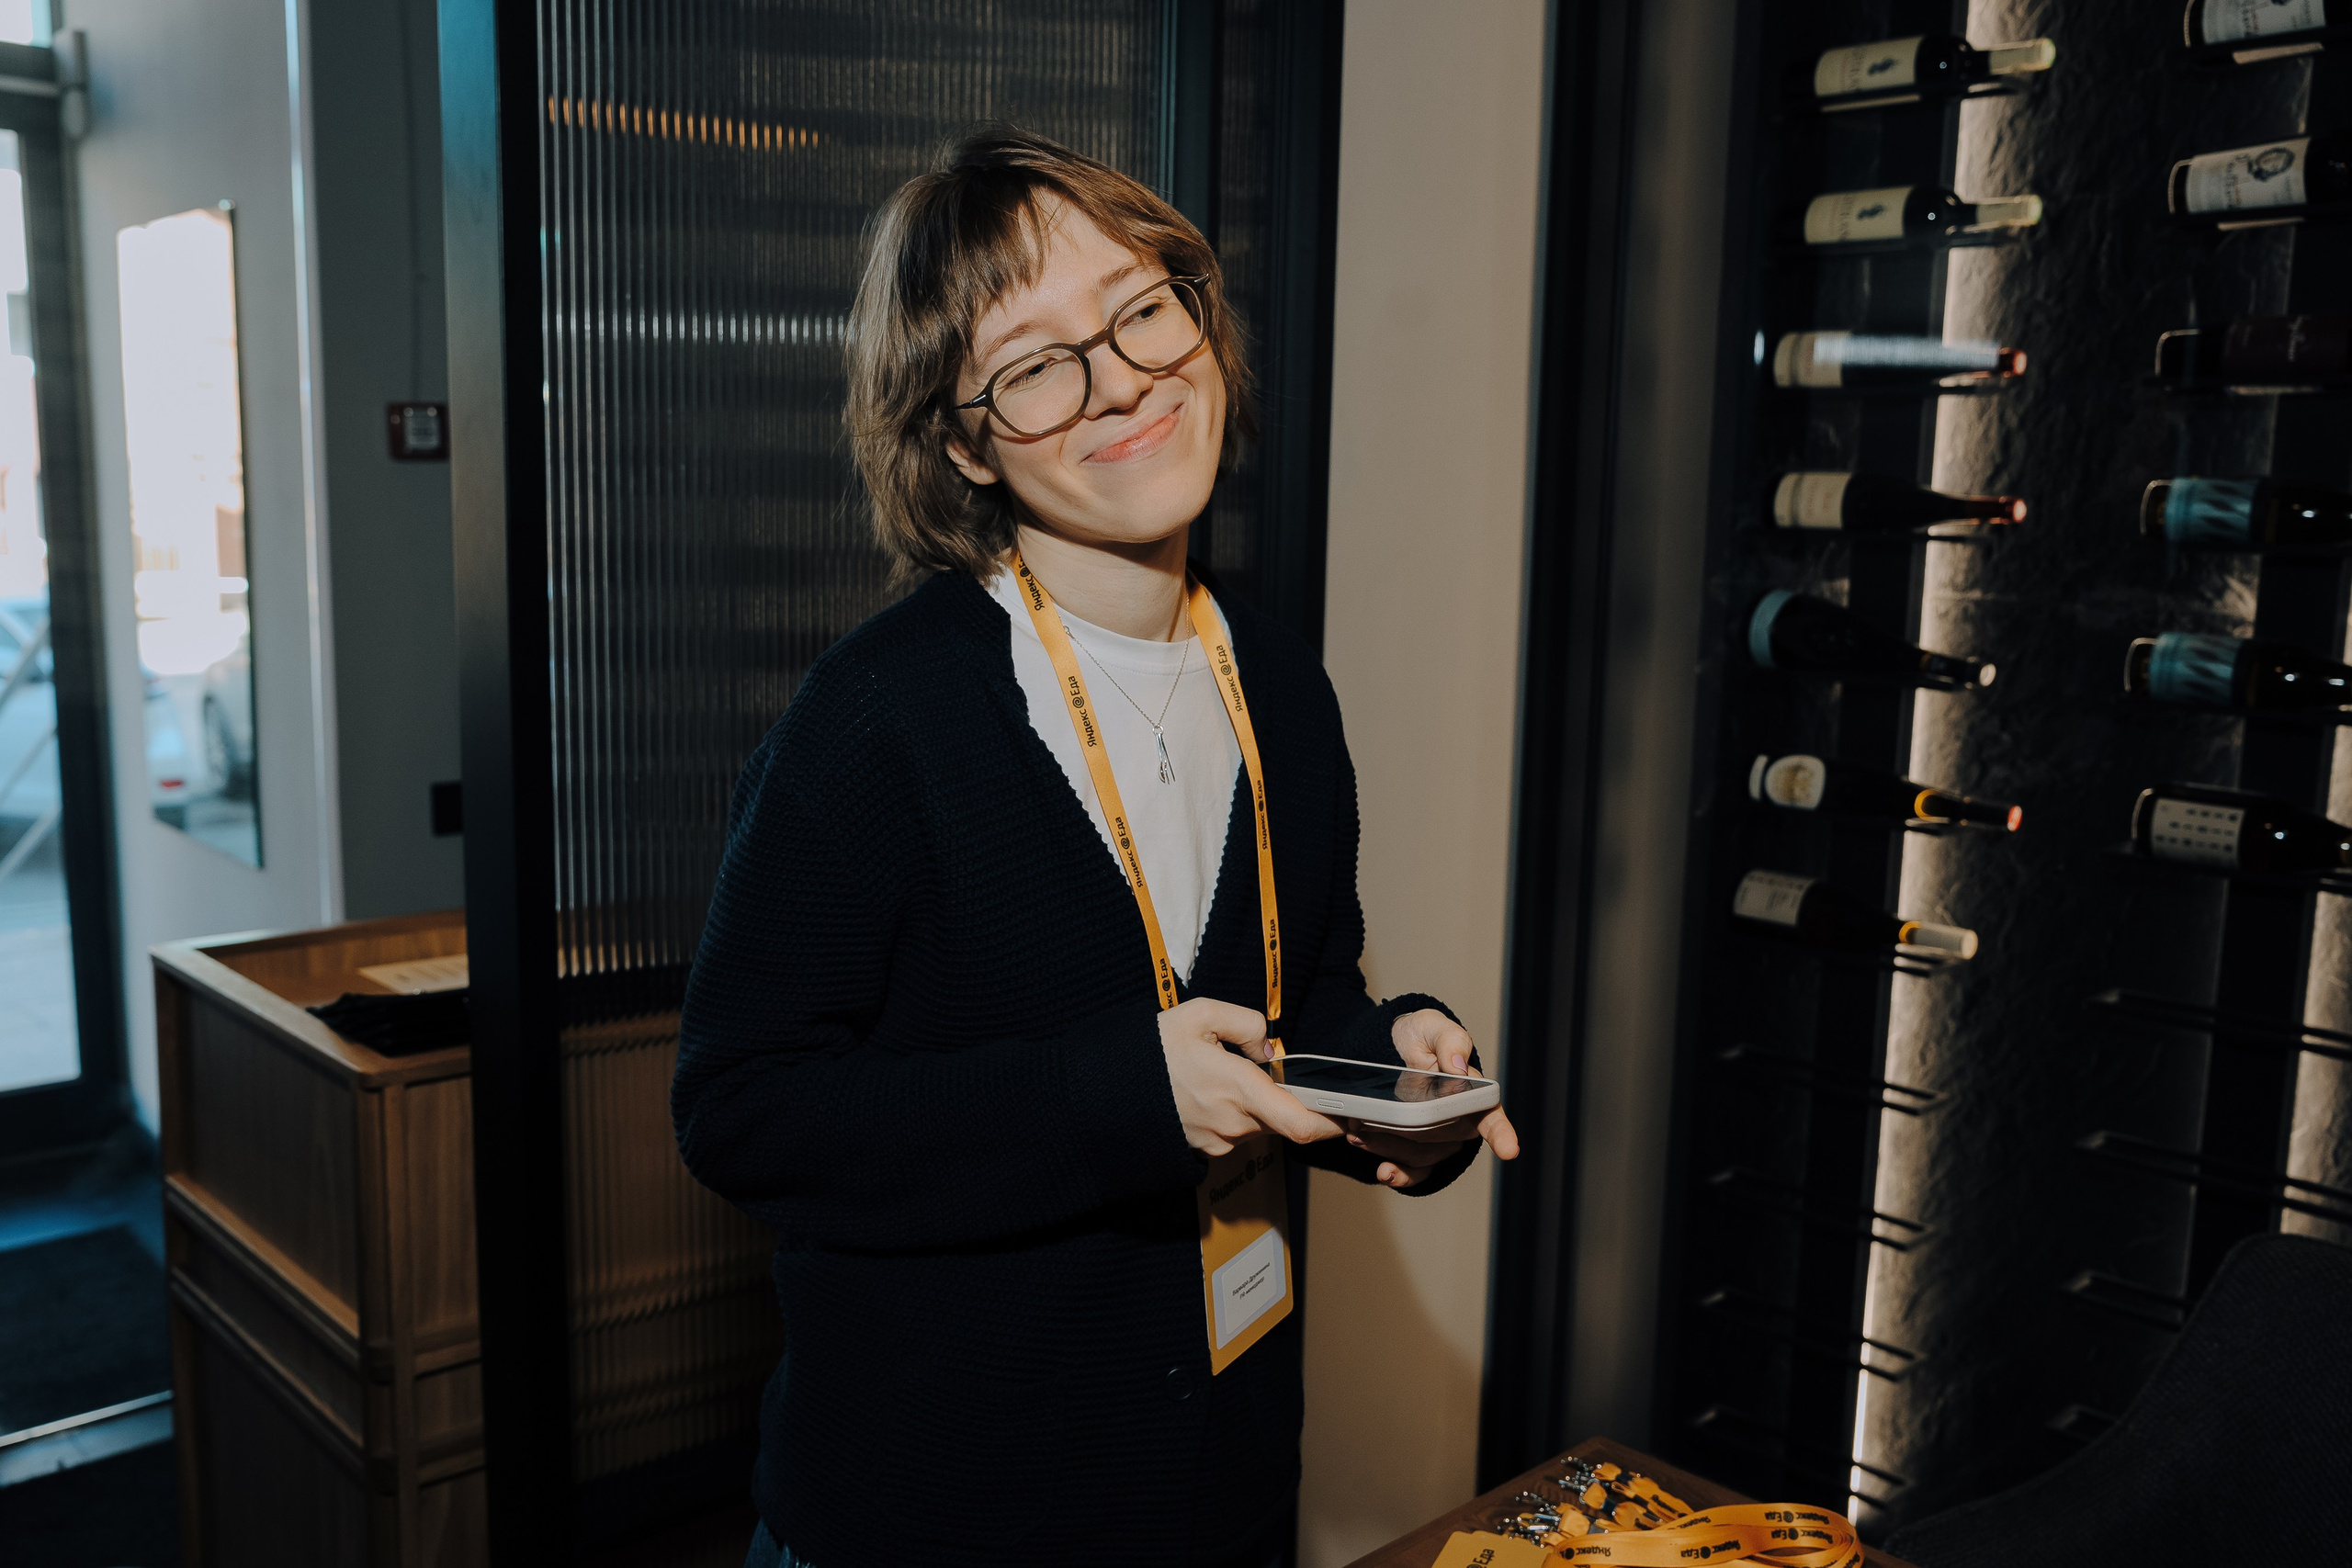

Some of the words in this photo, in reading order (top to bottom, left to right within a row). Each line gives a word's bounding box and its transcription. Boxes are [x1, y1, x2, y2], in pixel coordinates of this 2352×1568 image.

[1026, 575, 1046, 612] Яндекс
[1216, 644, 1227, 665] Еда
[1068, 675, 1080, 696] Еда
[1227, 676, 1243, 713] Яндекс
[1079, 708, 1097, 748] Яндекс
[1115, 817, 1126, 837] Еда
[1261, 812, 1269, 850] Яндекс
[1127, 851, 1143, 887] Яндекс
[1159, 958, 1169, 979] Еда
[1209, 1172, 1245, 1207] Яндекс
[1257, 1152, 1274, 1172] Еда
[1764, 1511, 1782, 1523] Еда
[1796, 1512, 1830, 1525] Яндекс
[1712, 1540, 1741, 1554] Яндекс
[1801, 1529, 1834, 1545] Яндекс
[1473, 1548, 1496, 1566] Еда
[1575, 1545, 1611, 1558] Яндекс
[1680, 1548, 1700, 1560] Еда
